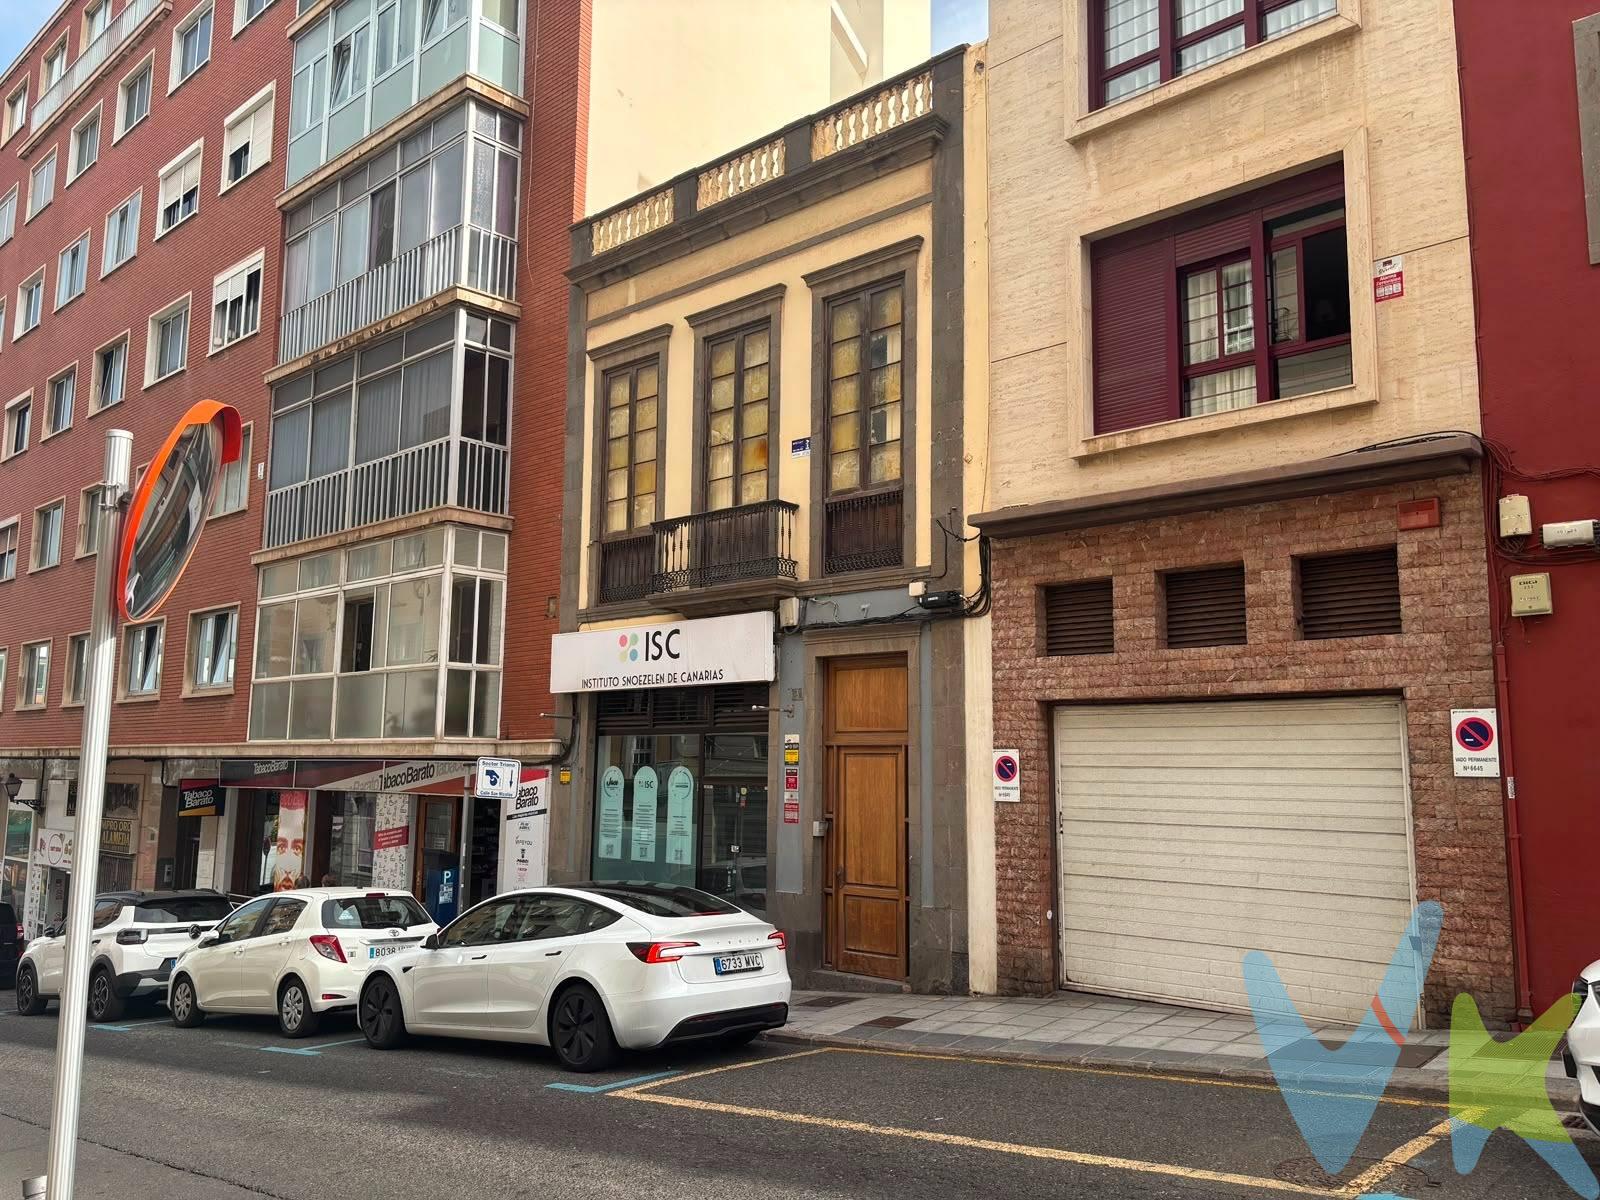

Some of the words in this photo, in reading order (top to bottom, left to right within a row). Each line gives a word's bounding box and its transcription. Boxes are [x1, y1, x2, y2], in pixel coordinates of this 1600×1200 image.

[644, 628, 681, 661] ISC
[581, 676, 620, 689] INSTITUTO
[622, 672, 665, 687] SNOEZELEN
[667, 672, 678, 684] DE
[680, 668, 724, 683] CANARIAS
[644, 780, 654, 789] ISC
[182, 788, 213, 803] Tabaco
[518, 785, 538, 799] abaco
[184, 796, 214, 809] Barato
[515, 796, 539, 810] Barato
[720, 957, 743, 970] 6733
[744, 954, 761, 968] MVC
